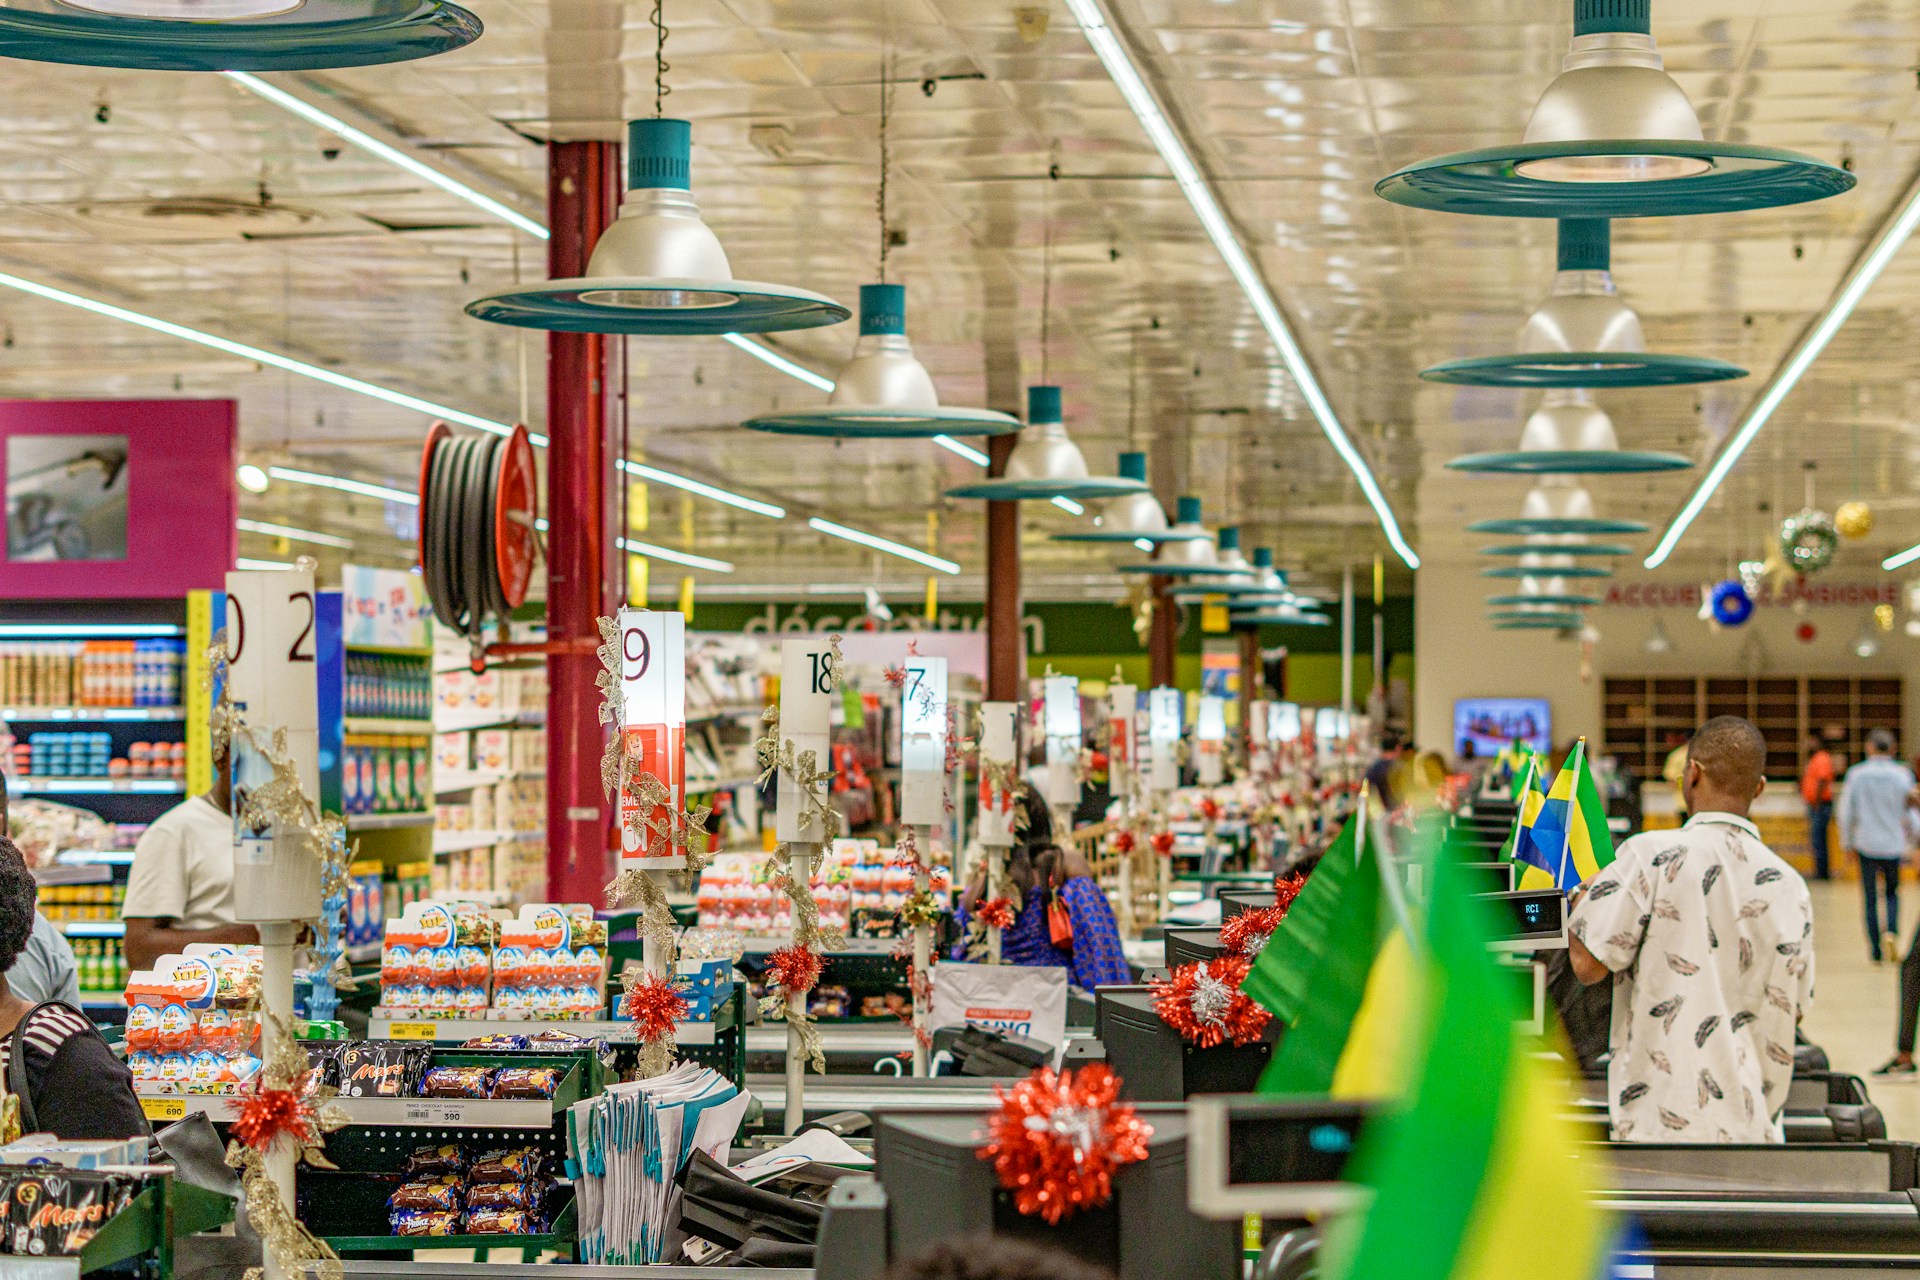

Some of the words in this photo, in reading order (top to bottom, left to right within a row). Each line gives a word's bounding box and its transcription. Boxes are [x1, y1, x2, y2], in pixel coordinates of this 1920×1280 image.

[1605, 584, 1697, 606] ACCUE
[288, 591, 315, 662] 2
[623, 627, 651, 681] 9
[906, 668, 926, 701] 7
[301, 1067, 325, 1078] ars
[351, 1063, 405, 1081] Mars
[29, 1202, 104, 1229] Mars
